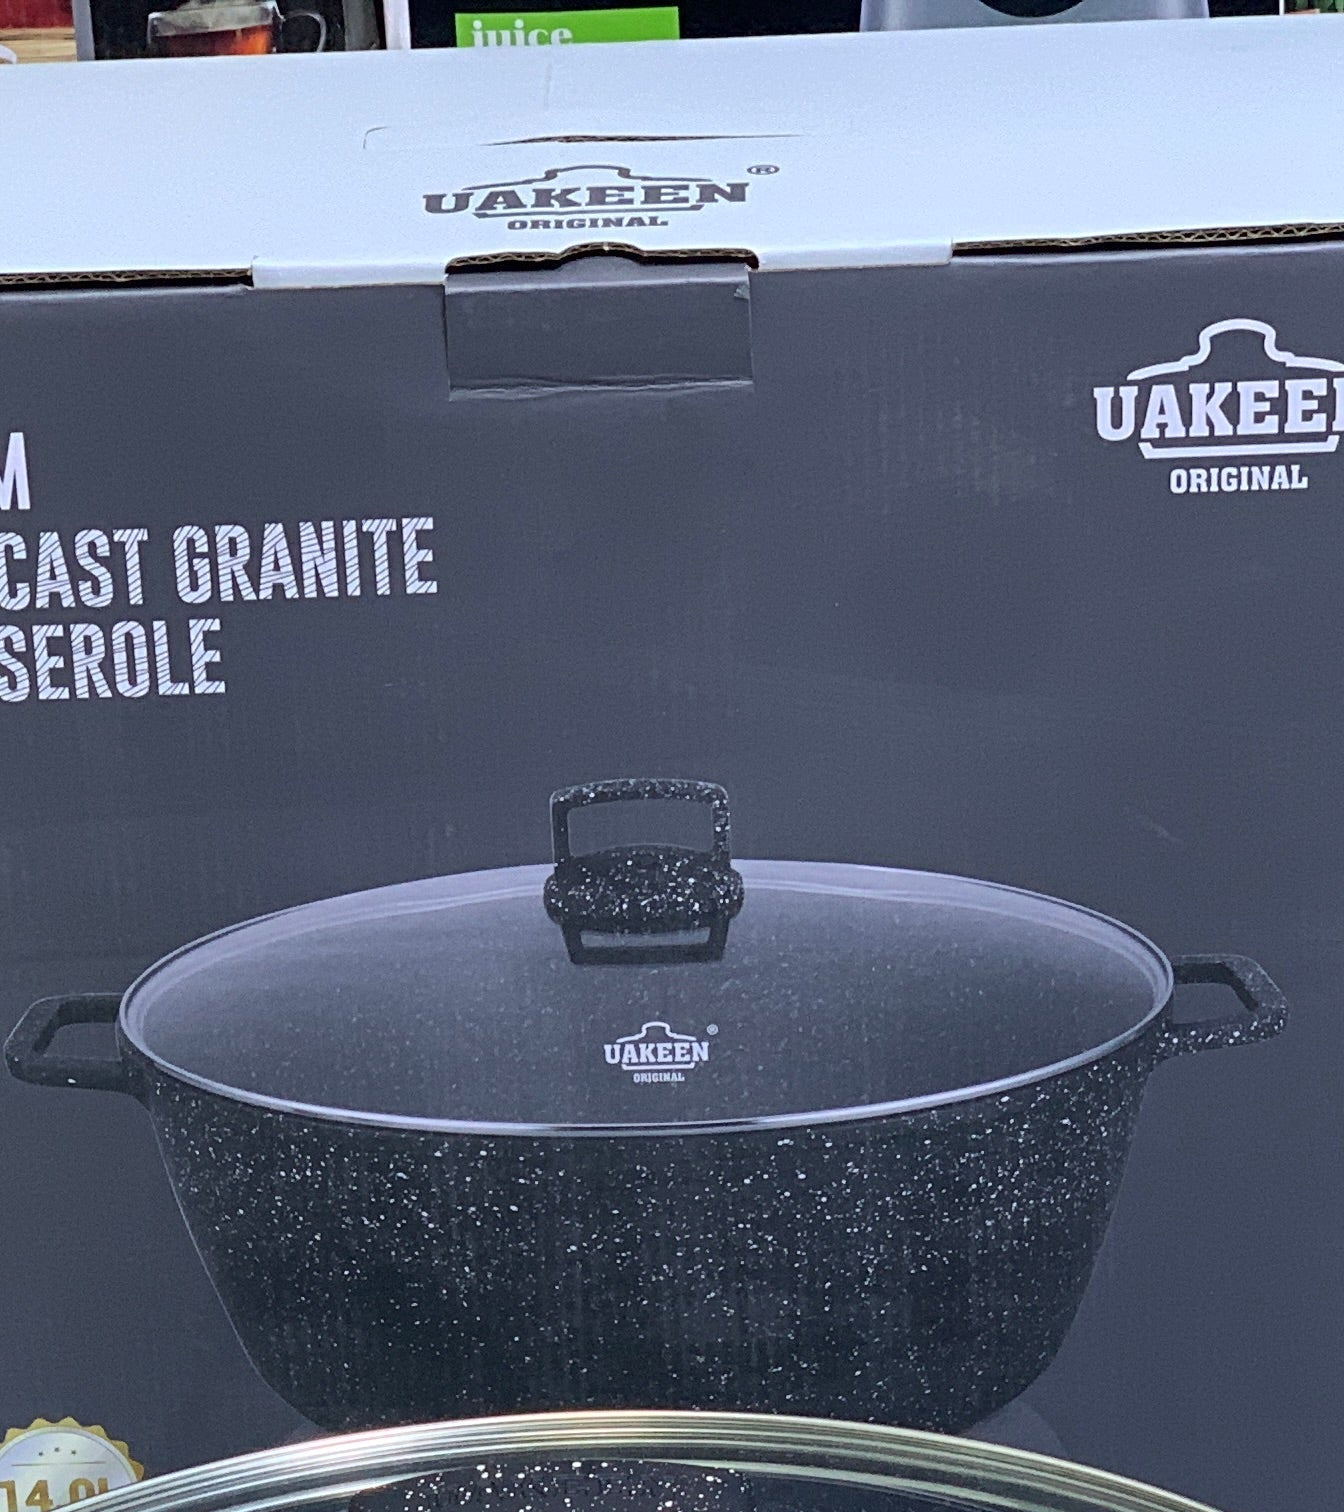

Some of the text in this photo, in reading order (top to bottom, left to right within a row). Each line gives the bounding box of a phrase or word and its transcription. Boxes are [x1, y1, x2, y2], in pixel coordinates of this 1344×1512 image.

[422, 183, 750, 214] UAKEEN
[507, 215, 669, 230] ORIGINAL
[1170, 464, 1308, 494] ORIGINAL
[173, 517, 438, 604] GRANITE
[604, 1041, 709, 1064] UAKEEN
[633, 1072, 685, 1083] ORIGINAL
